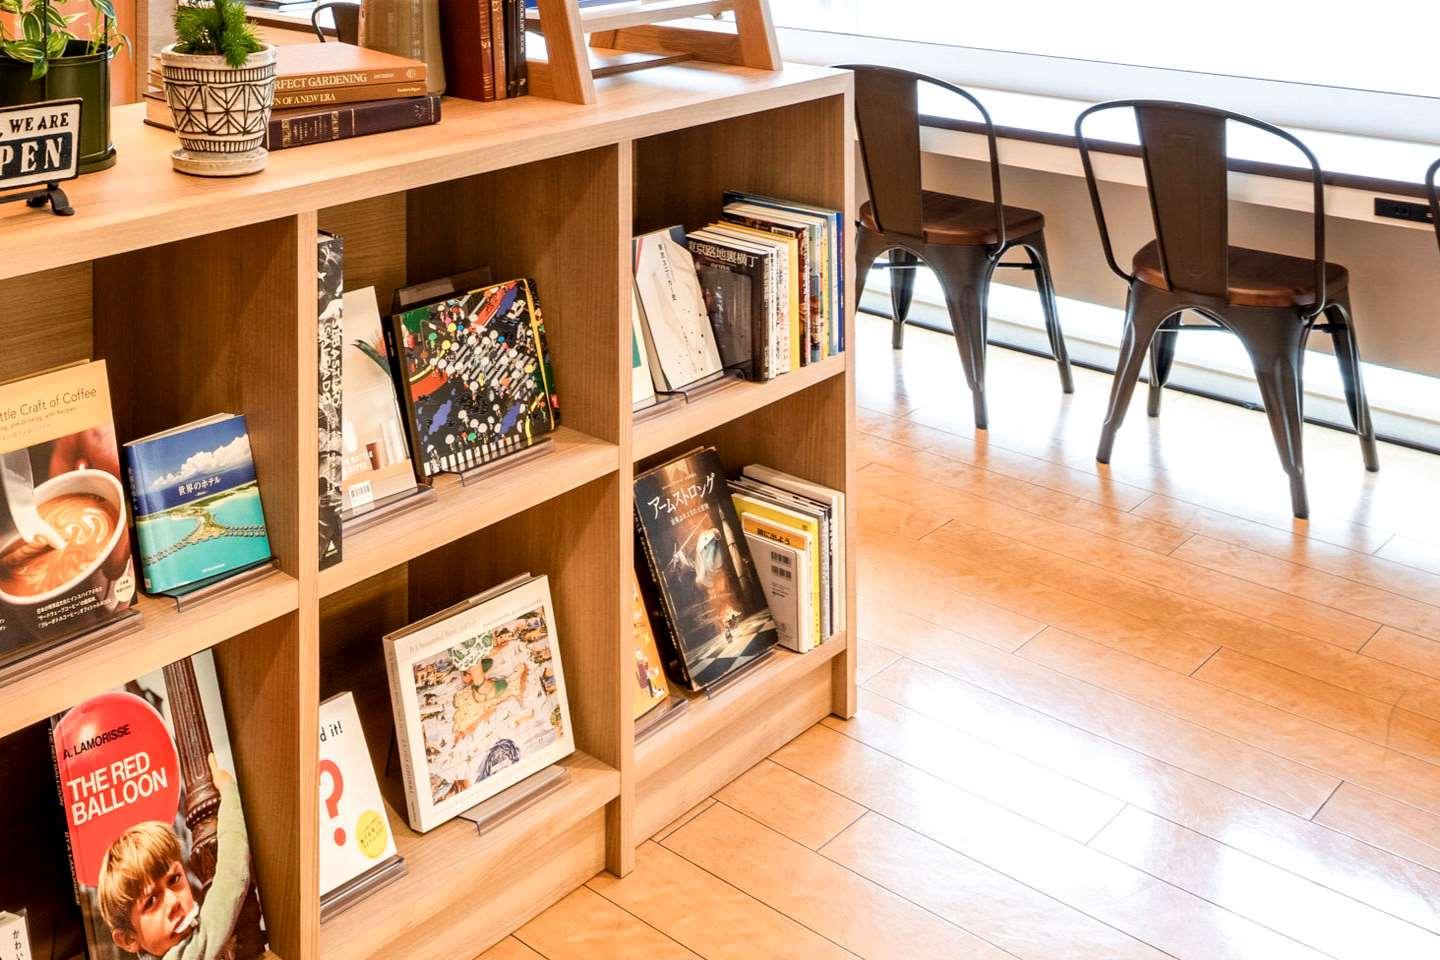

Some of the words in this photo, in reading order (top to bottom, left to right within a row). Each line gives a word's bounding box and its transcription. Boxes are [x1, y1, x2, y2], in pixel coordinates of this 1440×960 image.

[308, 73, 368, 87] GARDENING
[282, 97, 295, 105] OF
[300, 94, 319, 103] NEW
[320, 93, 336, 102] ERA
[9, 117, 33, 133] WE
[37, 112, 69, 131] ARE
[20, 401, 47, 416] Craft
[50, 394, 60, 407] of
[62, 387, 97, 404] Coffee
[178, 476, 221, 496] 世界のホテル
[648, 472, 716, 520] アームストロング
[74, 724, 131, 756] LAMORISSE
[66, 768, 109, 800] THE
[110, 752, 150, 785] RED
[71, 767, 168, 826] BALLOON
